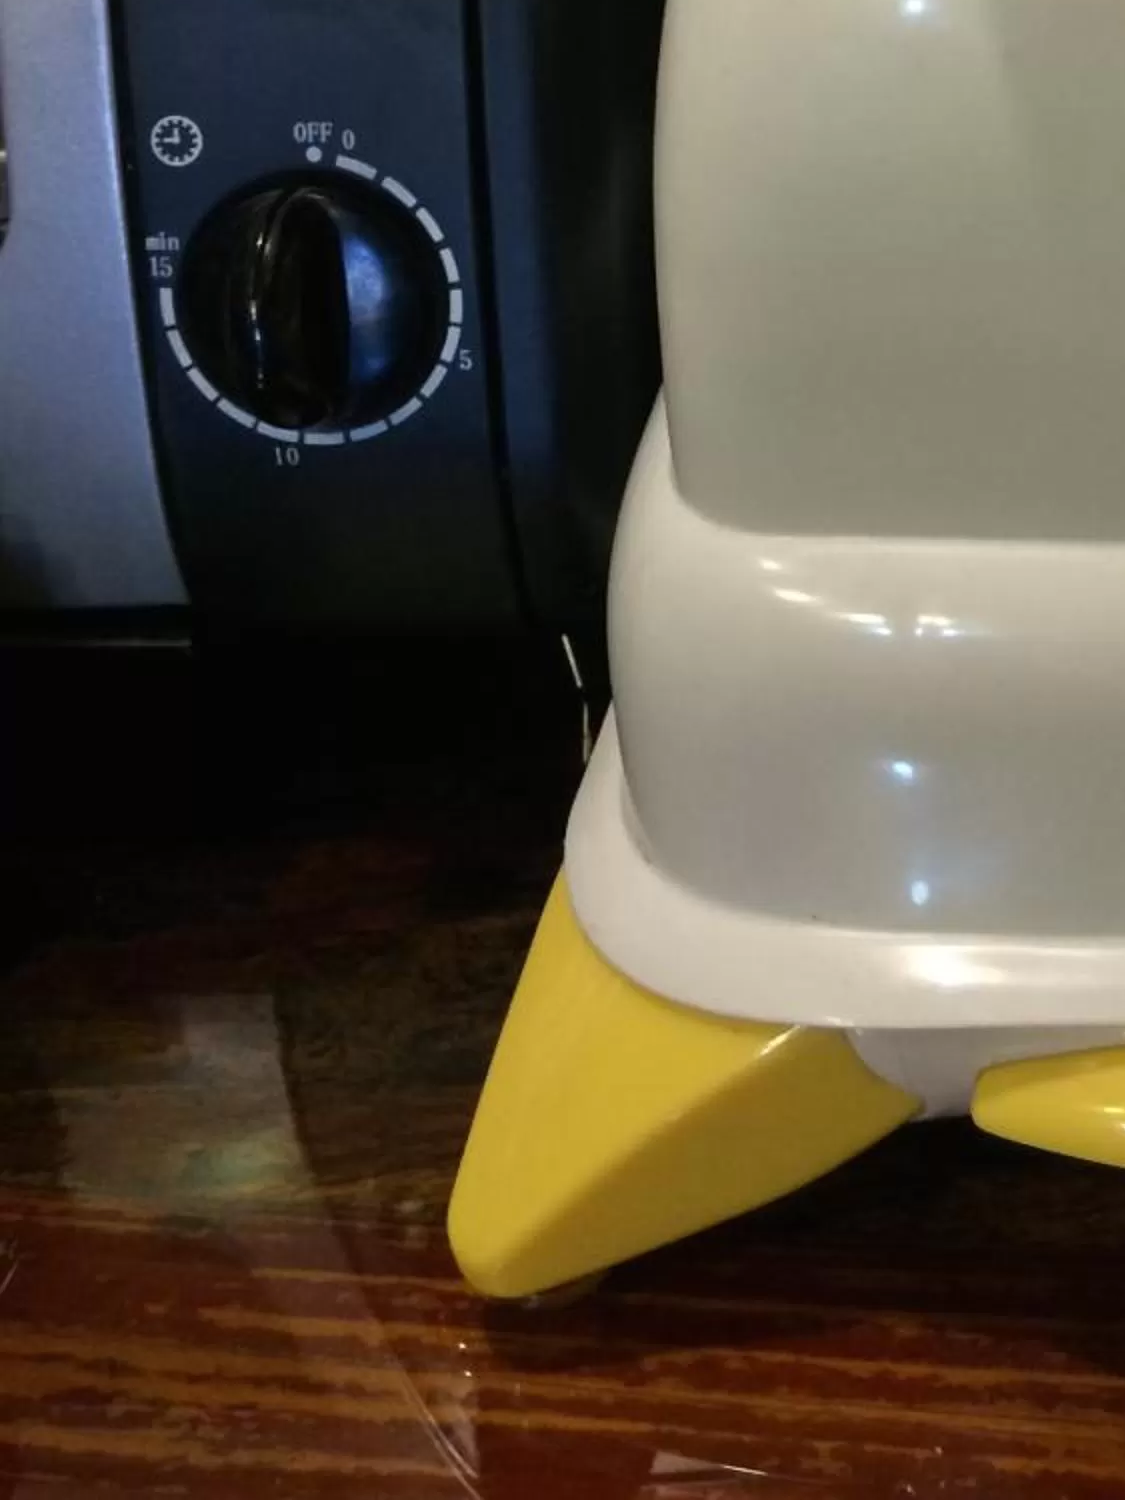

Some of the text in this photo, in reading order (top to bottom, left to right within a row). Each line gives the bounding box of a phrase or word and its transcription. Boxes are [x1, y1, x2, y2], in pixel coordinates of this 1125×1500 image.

[292, 121, 356, 150] OFF 0
[145, 232, 180, 251] min
[149, 256, 173, 278] 15
[459, 350, 473, 370] 5
[275, 447, 300, 466] 10
